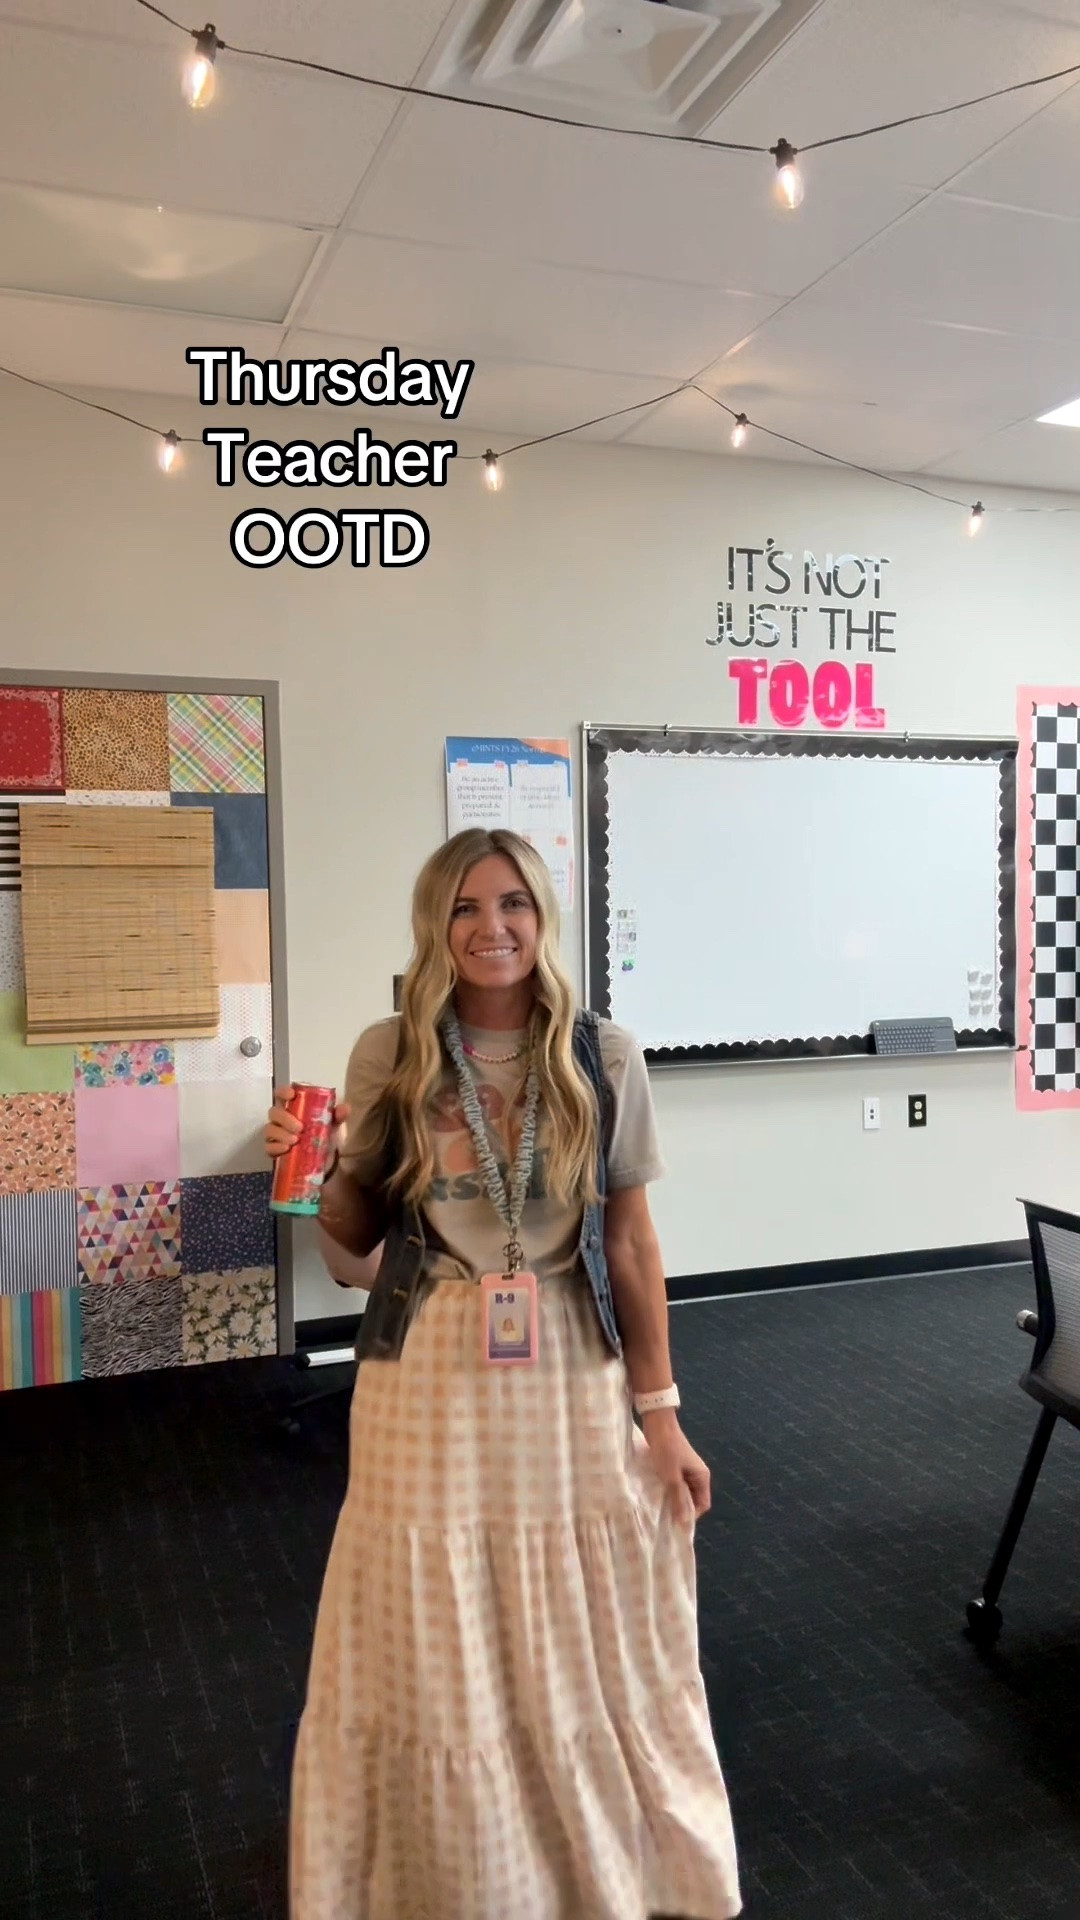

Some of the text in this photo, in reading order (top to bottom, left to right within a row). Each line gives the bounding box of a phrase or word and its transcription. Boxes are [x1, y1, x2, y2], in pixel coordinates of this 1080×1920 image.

[728, 538, 890, 599] IT'S NOT
[705, 601, 896, 653] JUST THE
[728, 656, 886, 729] TOOL
